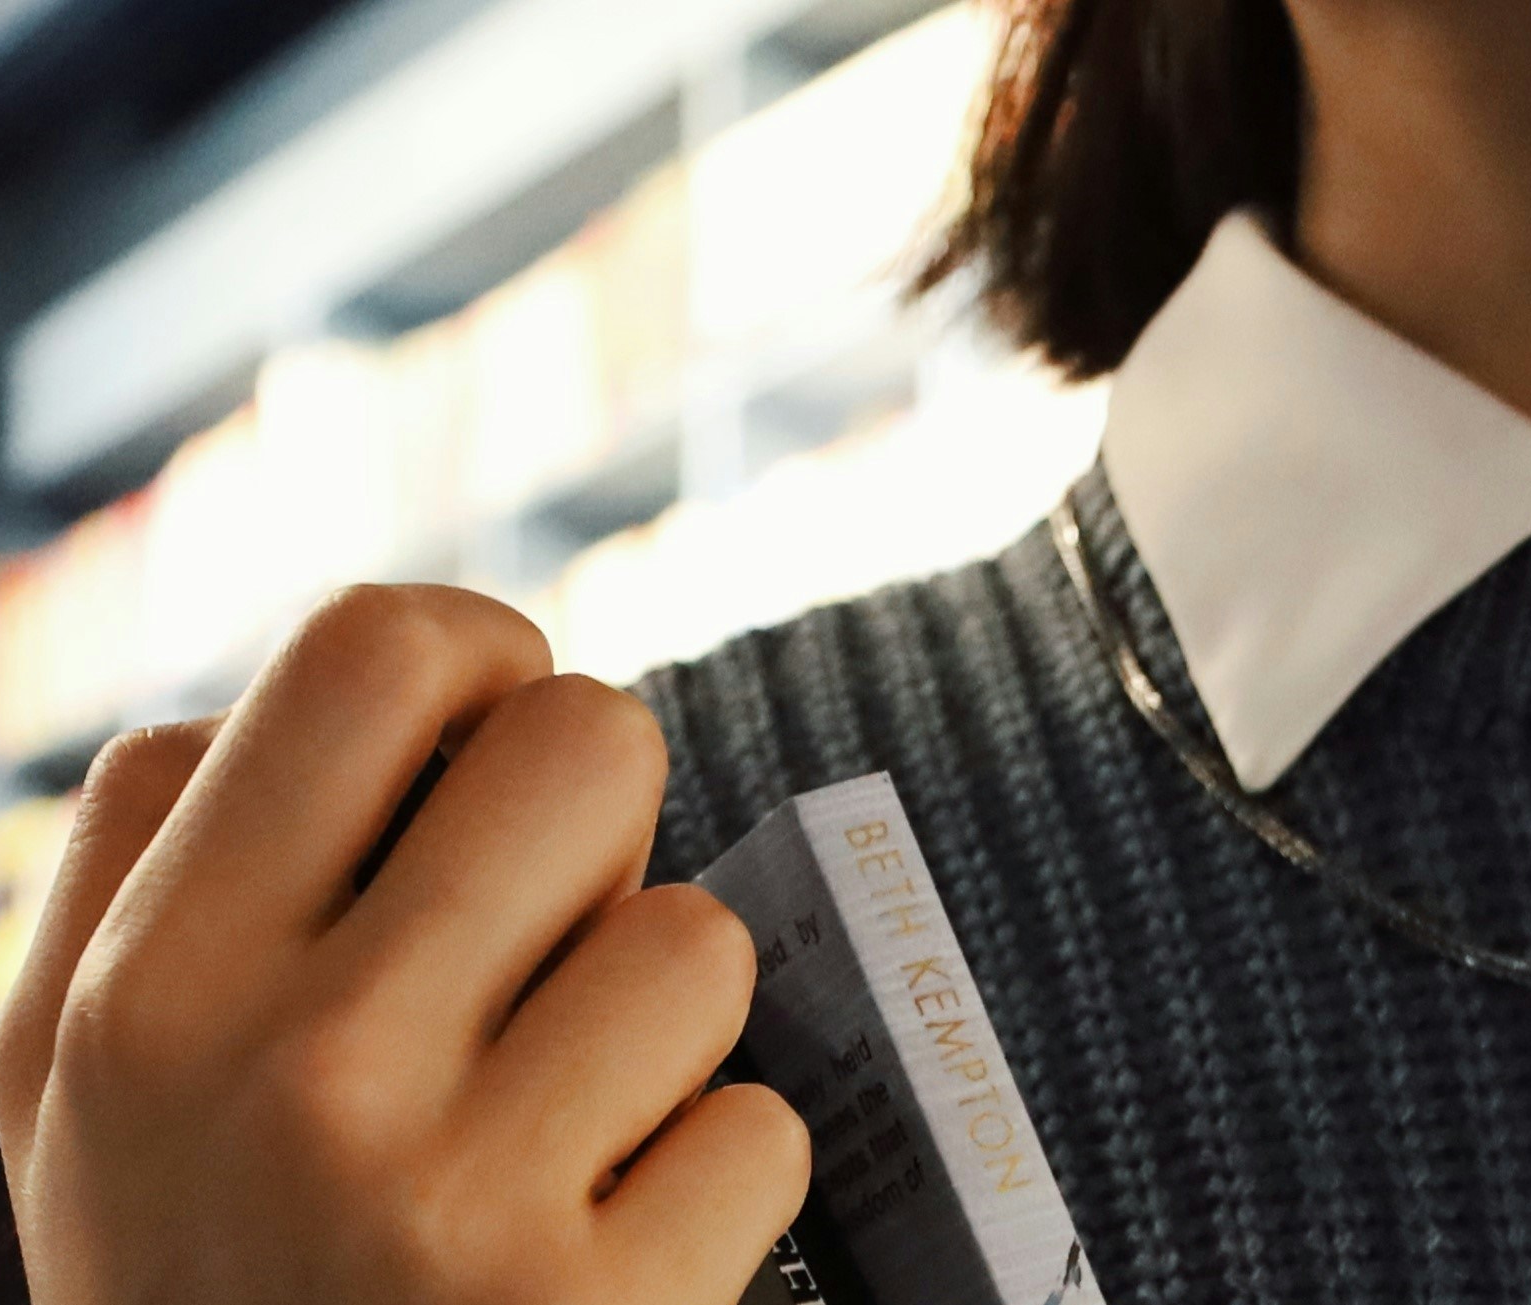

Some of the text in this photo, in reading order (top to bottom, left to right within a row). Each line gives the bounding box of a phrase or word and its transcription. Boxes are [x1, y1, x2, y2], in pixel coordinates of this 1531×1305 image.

[794, 909, 821, 944] by
[843, 818, 1033, 1197] BETH KEMPTON
